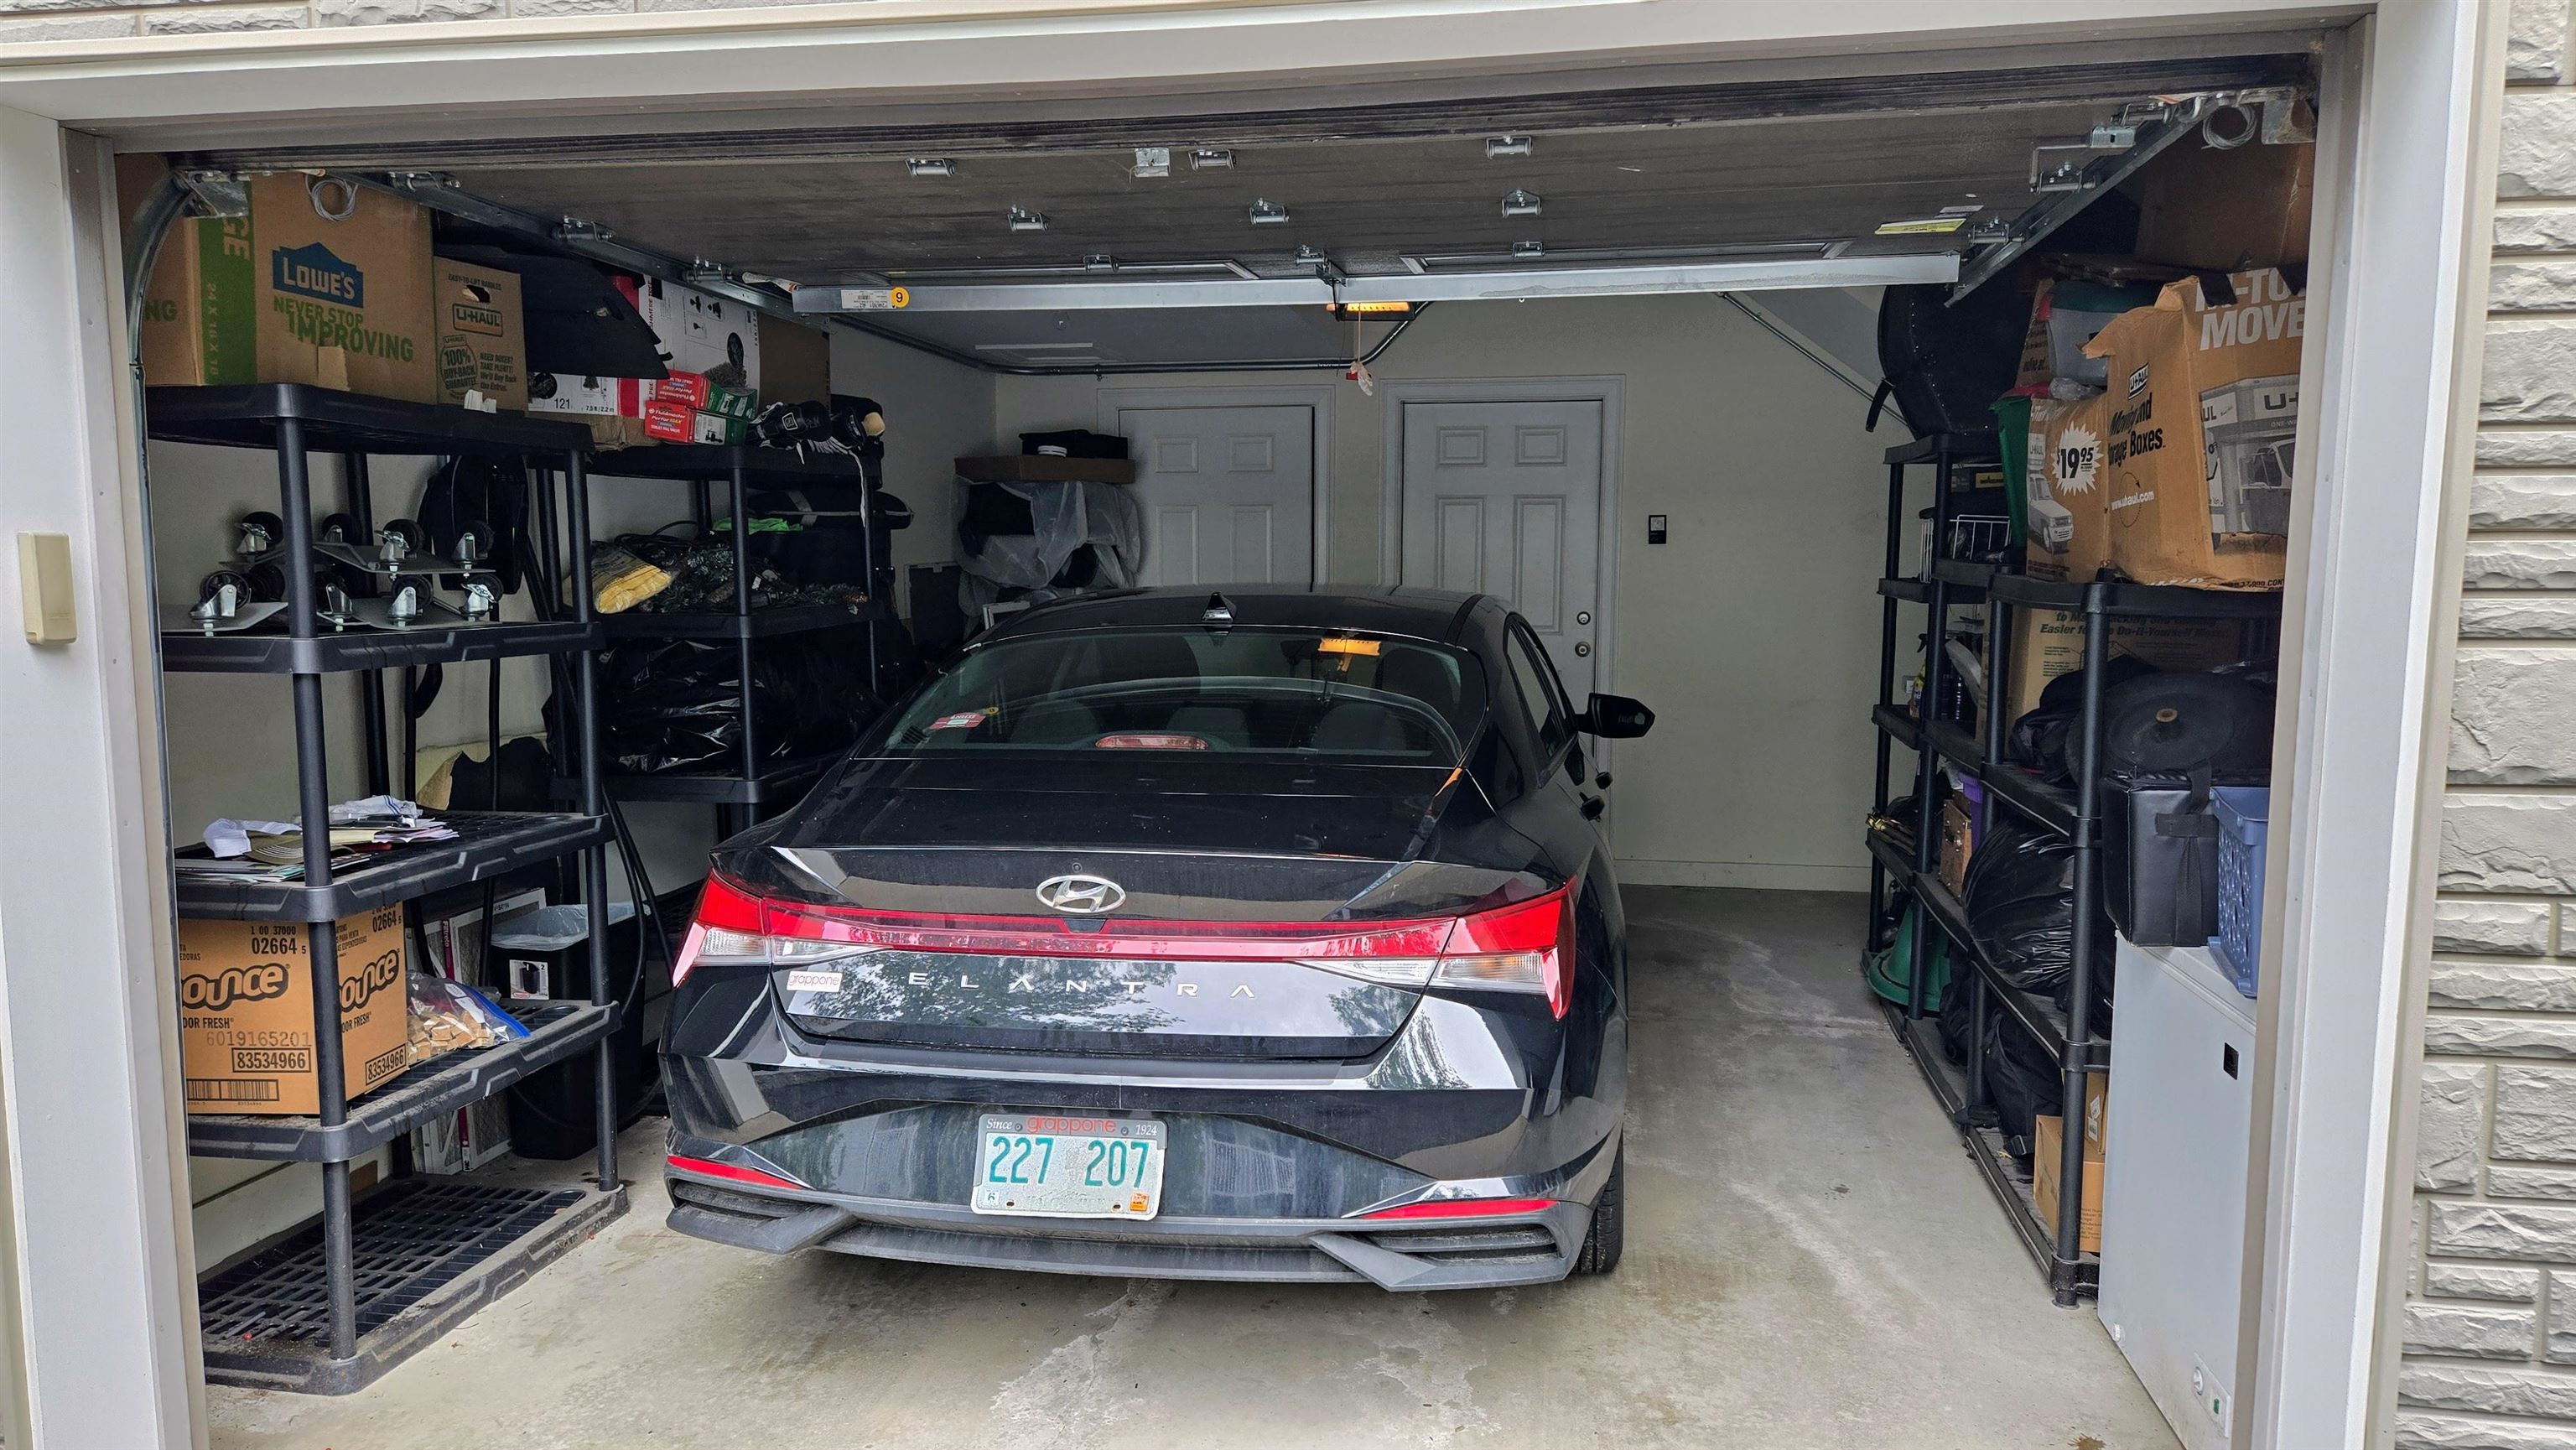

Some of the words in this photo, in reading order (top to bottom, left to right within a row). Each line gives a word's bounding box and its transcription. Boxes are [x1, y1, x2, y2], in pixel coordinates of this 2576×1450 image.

[283, 257, 355, 299] LOWE'S
[896, 292, 903, 303] 9
[273, 295, 324, 320] NEVER
[328, 308, 363, 328] STOP
[455, 308, 501, 326] U-HAUL
[288, 311, 413, 362] IMPROVING
[444, 348, 471, 366] 100%
[444, 365, 475, 379] BUY-BACK
[554, 398, 570, 409] 121
[655, 410, 686, 418] Fluidmaster
[2040, 623, 2075, 635] Easier
[259, 926, 269, 935] 00
[273, 926, 297, 935] 37000
[372, 910, 397, 933] 02664
[252, 938, 298, 954] 02664
[302, 945, 307, 954] 5
[179, 963, 289, 1011] ounce
[340, 949, 399, 1012] ounce
[788, 974, 839, 986] grappone
[908, 972, 1255, 999] ELANTRA
[206, 1031, 313, 1047] 6019165201
[237, 1052, 306, 1069] 83534966
[368, 1048, 404, 1081] 83534966
[986, 1118, 1013, 1130] Since
[1026, 1116, 1117, 1135] grappone
[1135, 1124, 1158, 1136] 1924
[989, 1136, 1054, 1184] 227
[1084, 1140, 1150, 1188] 207
